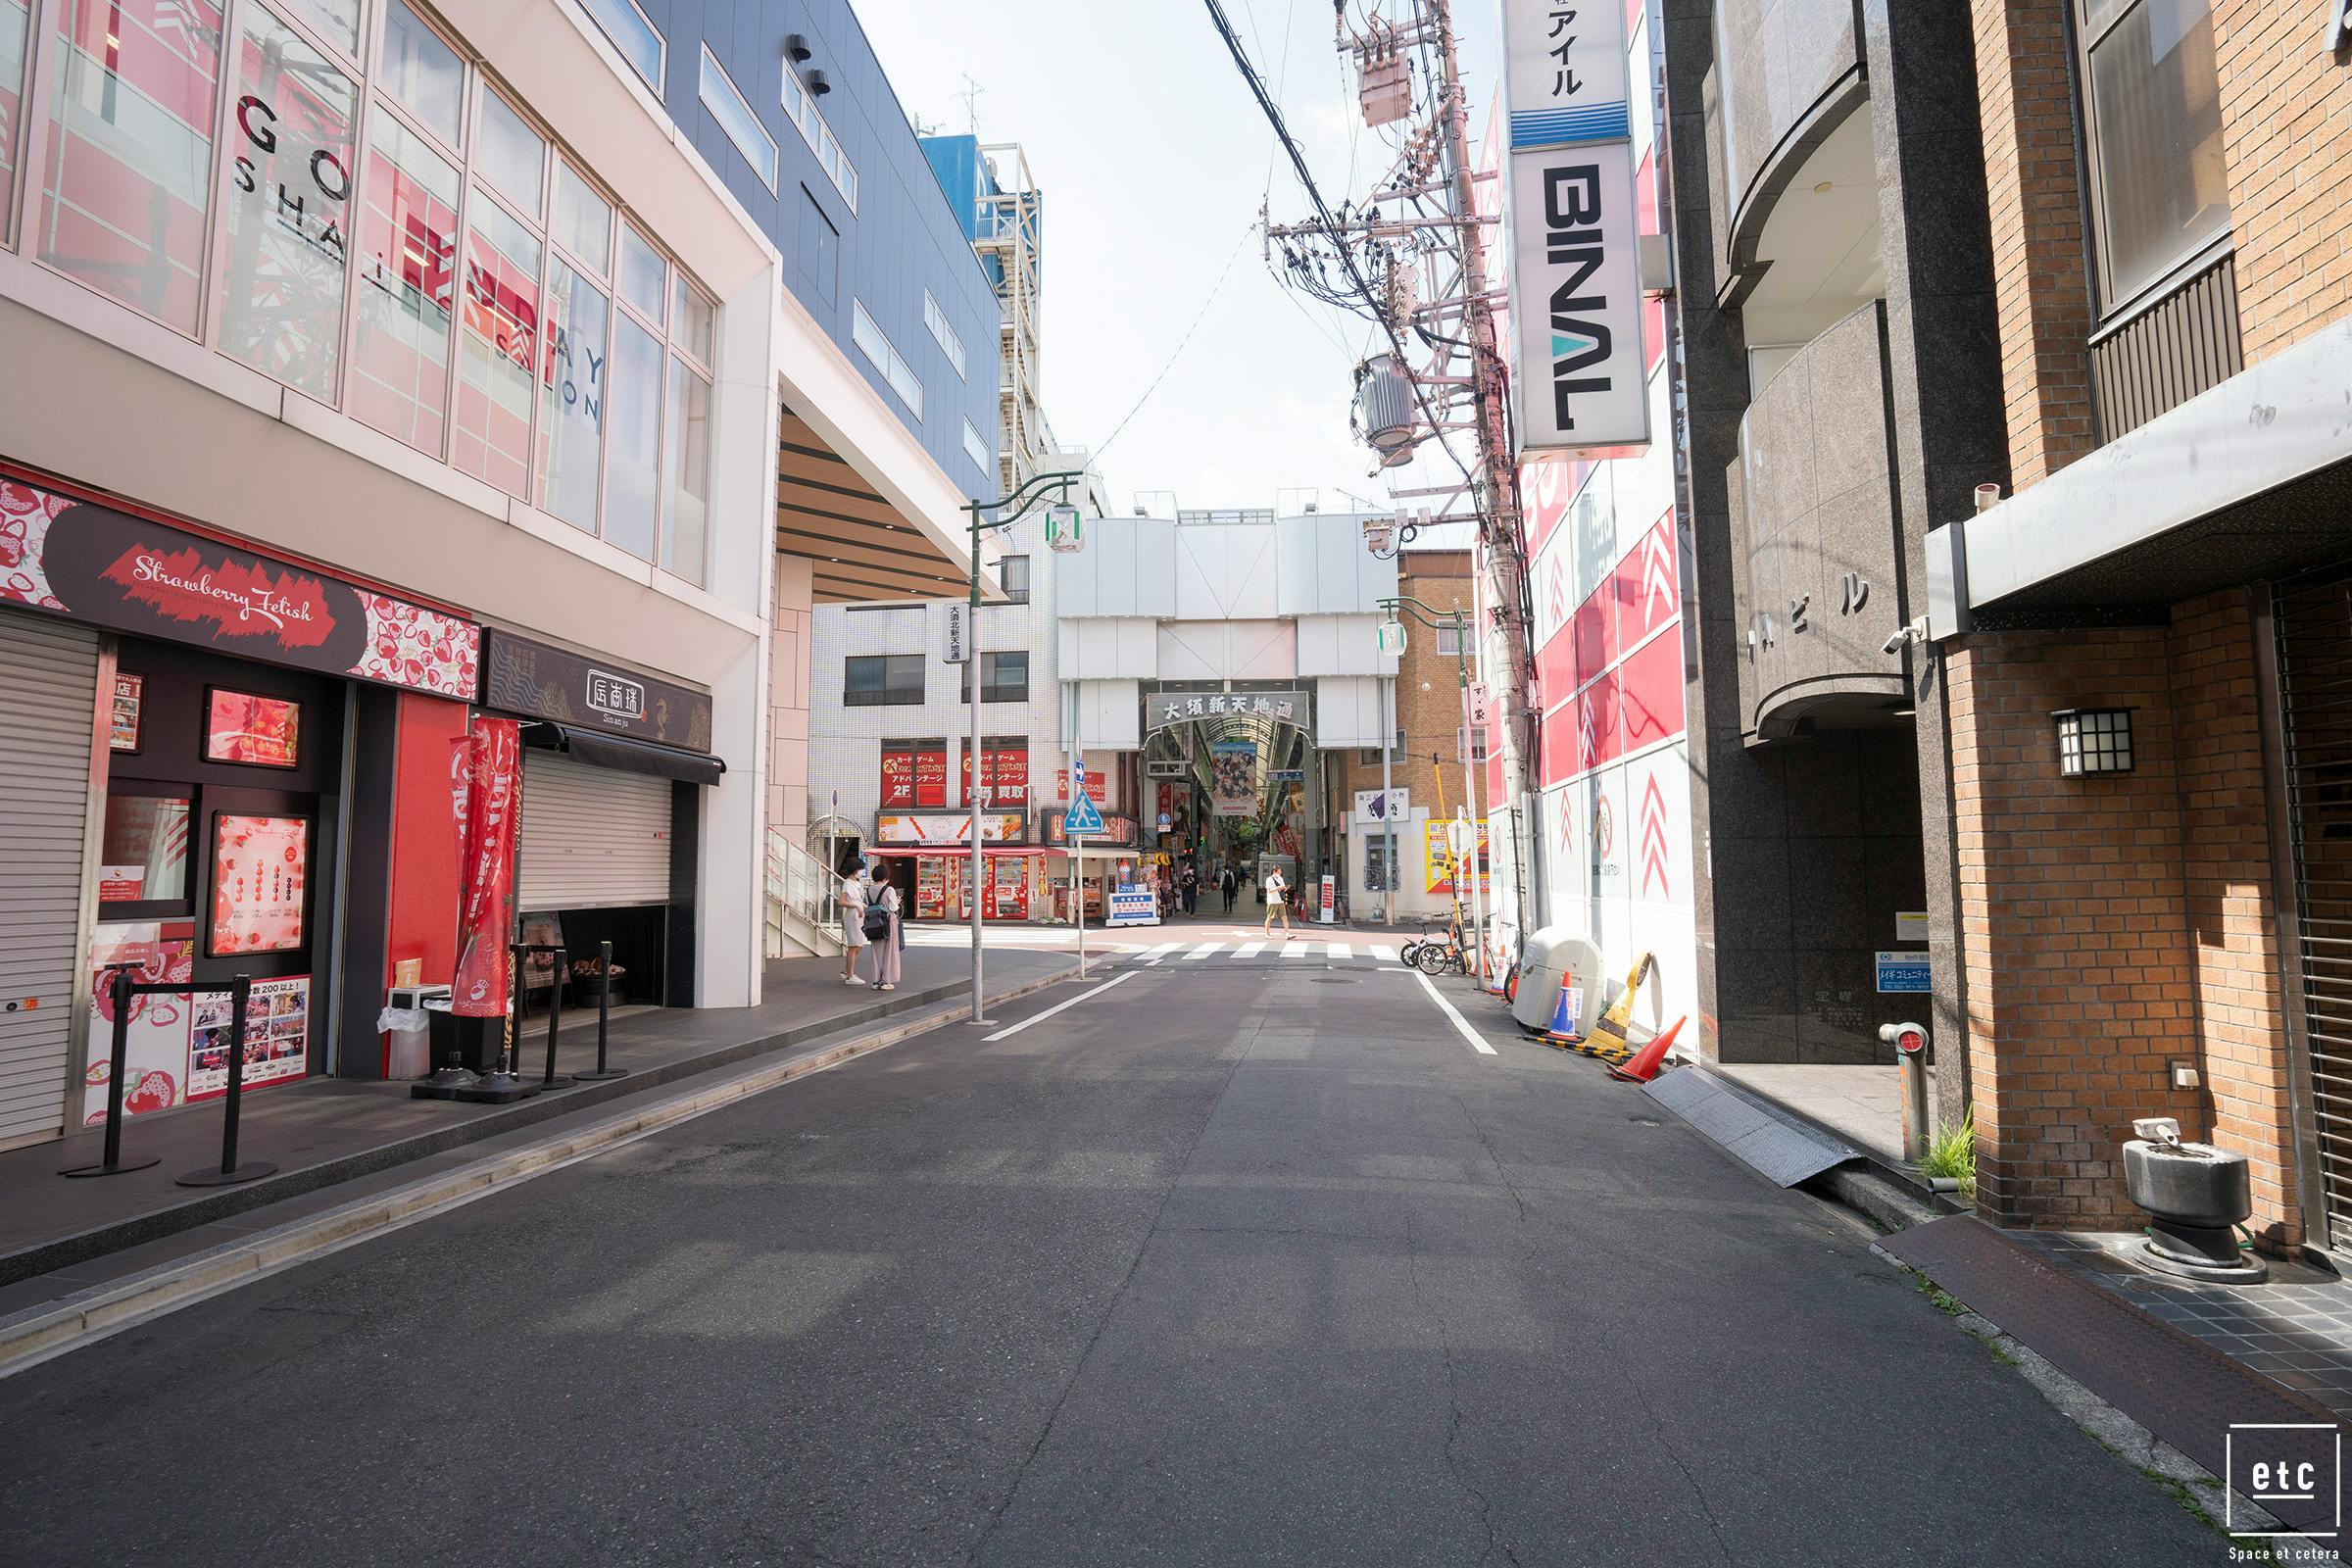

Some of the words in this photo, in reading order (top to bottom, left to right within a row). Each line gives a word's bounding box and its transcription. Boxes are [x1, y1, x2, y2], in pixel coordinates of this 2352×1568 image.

[237, 95, 351, 202] GO
[1544, 164, 1612, 431] BINAL
[133, 555, 283, 629] Strawberry
[251, 587, 315, 621] Fetish
[950, 605, 960, 661] 大須北新天地通
[1163, 695, 1294, 720] 大須新天地通
[894, 785, 910, 796] 2F
[980, 773, 1025, 782] ドバンテージ
